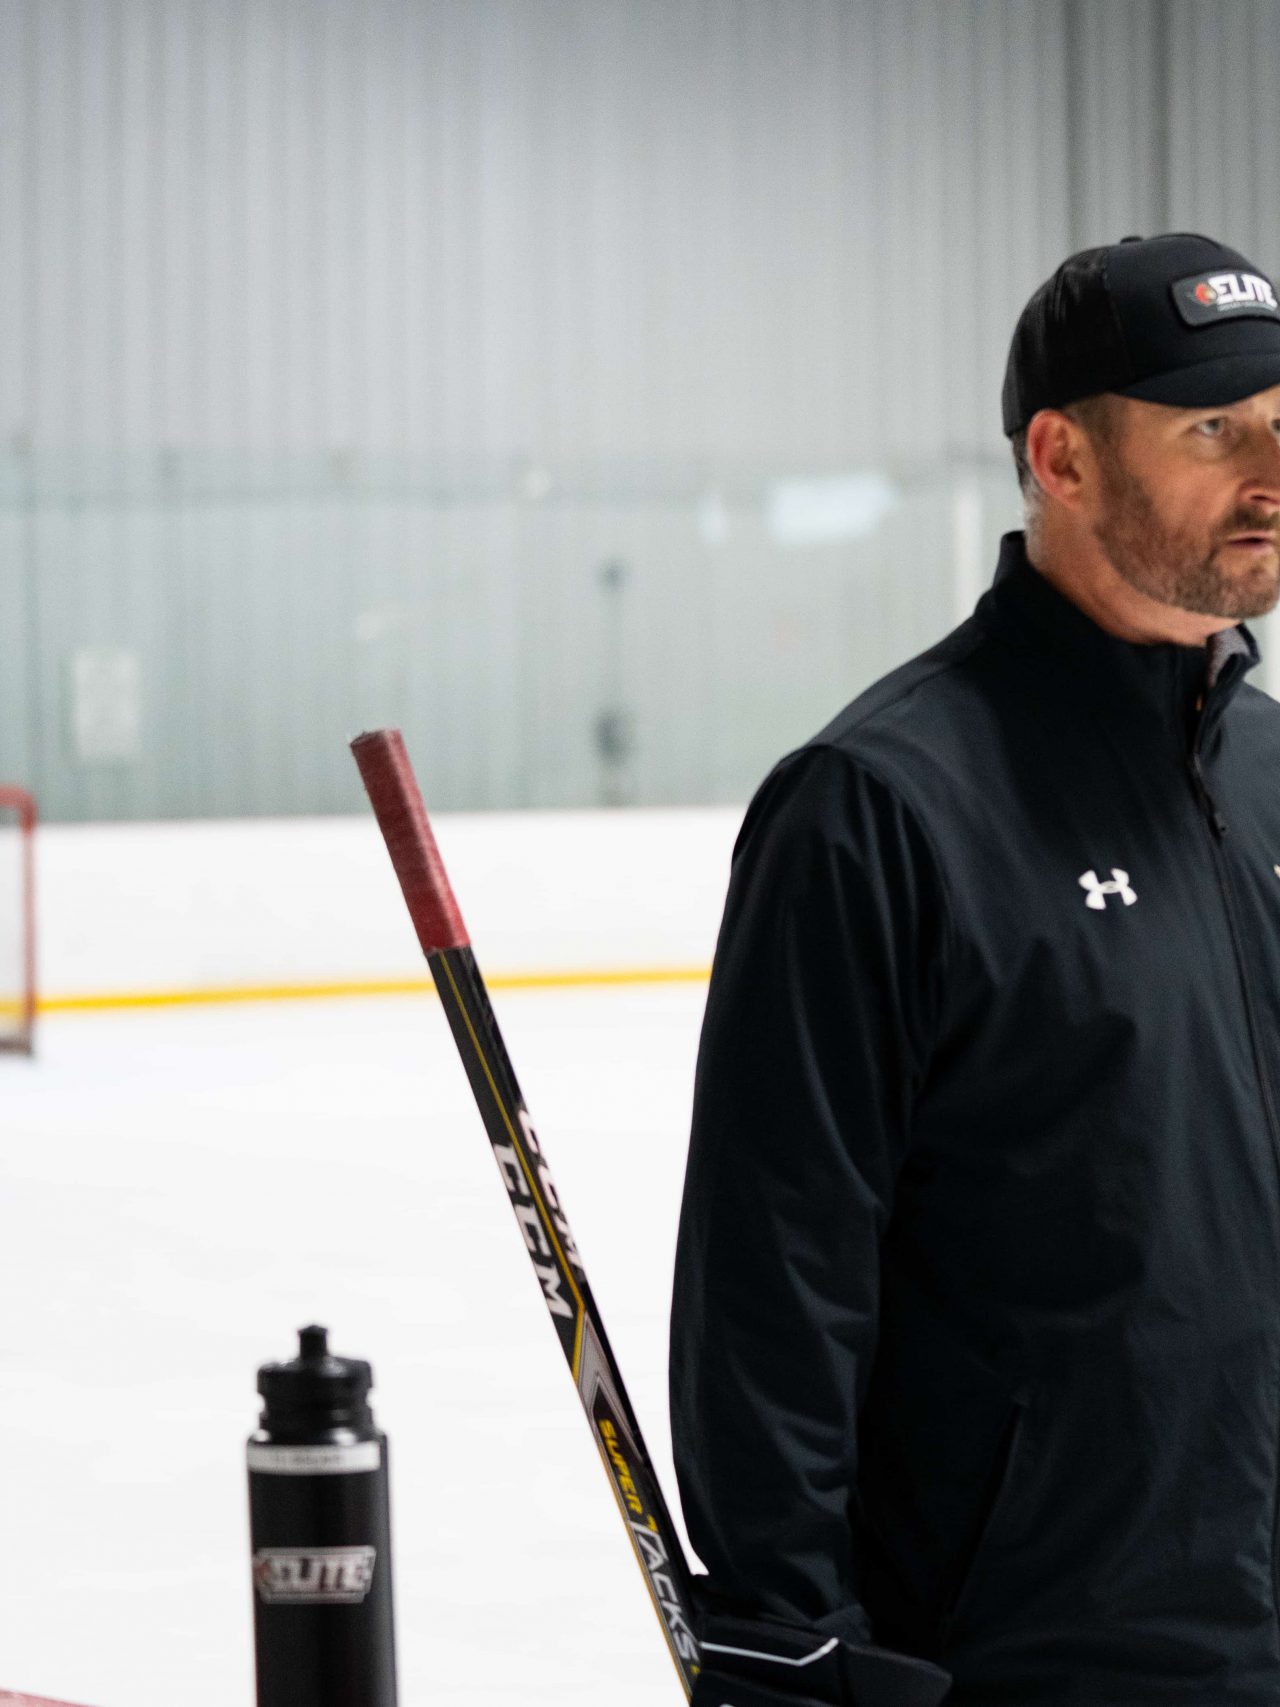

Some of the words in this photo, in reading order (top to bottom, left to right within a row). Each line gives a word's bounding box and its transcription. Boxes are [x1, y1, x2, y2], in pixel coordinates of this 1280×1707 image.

[493, 1143, 574, 1320] CCM
[598, 1418, 644, 1515] SUPER
[629, 1514, 701, 1665] TACKS
